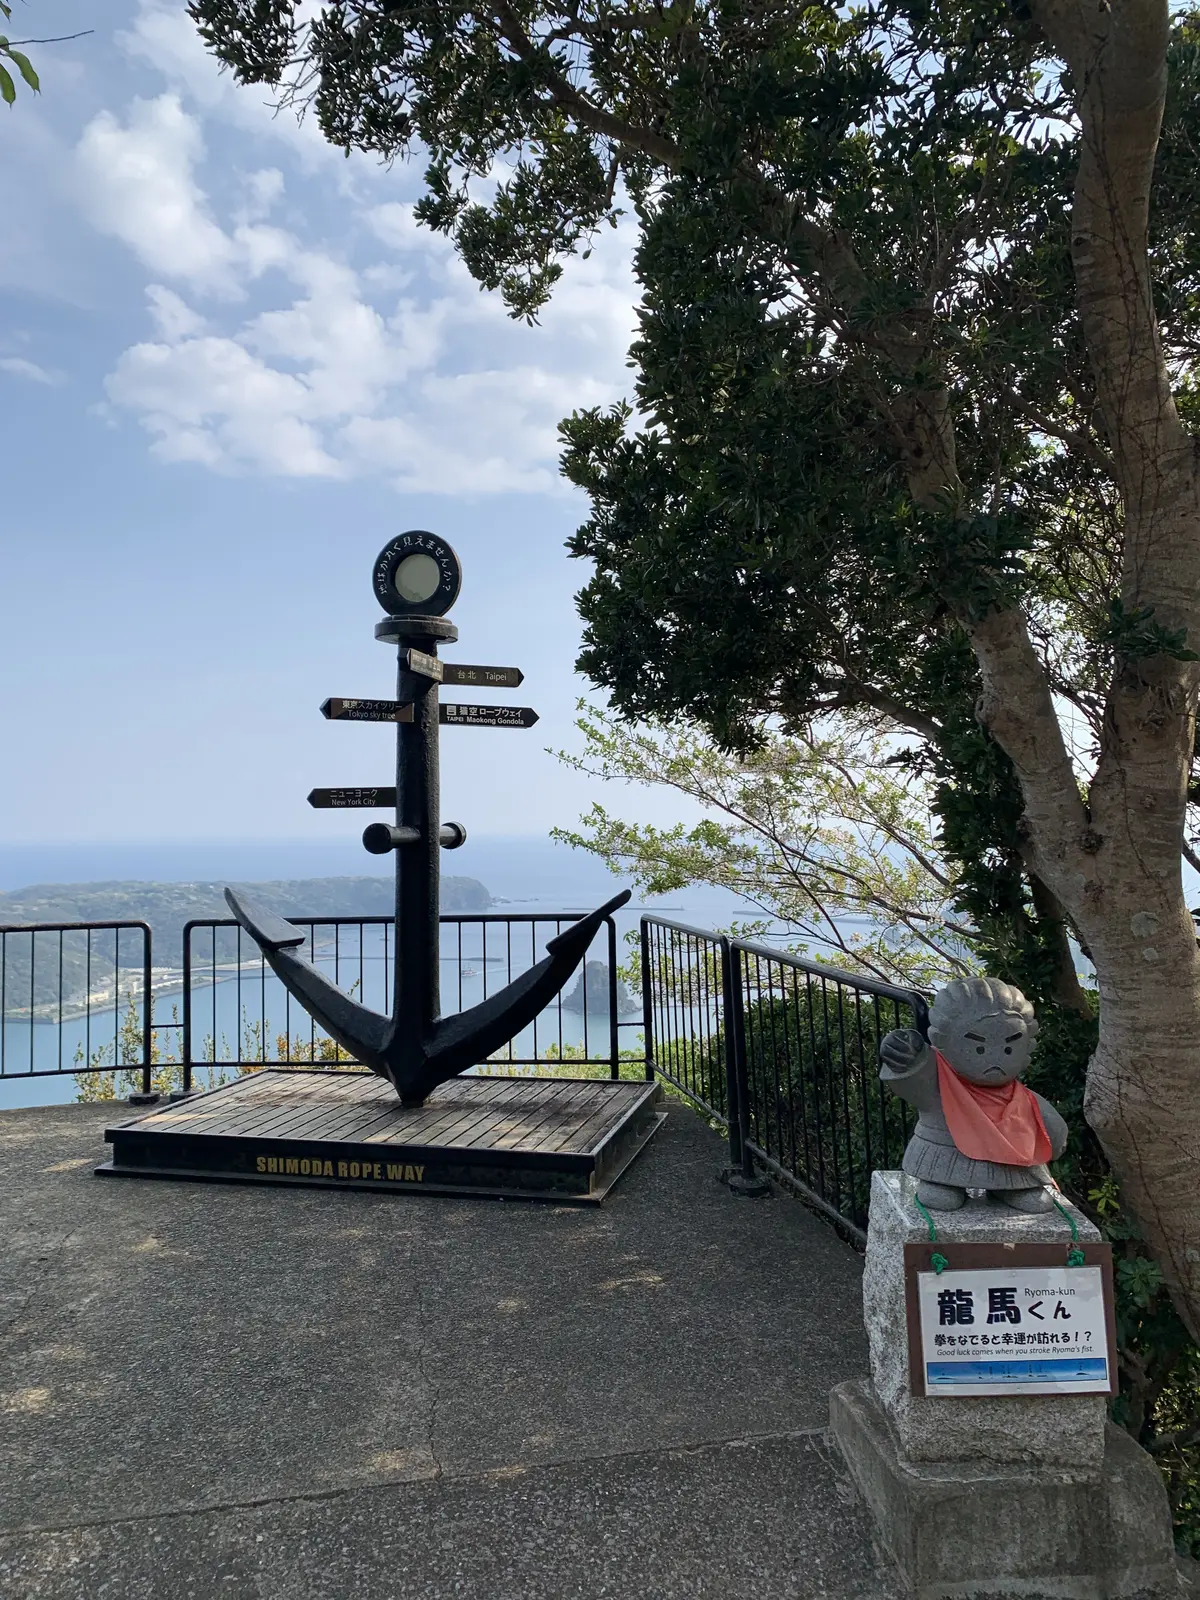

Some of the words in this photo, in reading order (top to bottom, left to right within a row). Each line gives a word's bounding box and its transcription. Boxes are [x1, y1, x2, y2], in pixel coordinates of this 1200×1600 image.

[457, 670, 477, 679] 台北
[485, 671, 507, 681] Taipei
[342, 700, 403, 710] 東京スカイツリー
[348, 710, 369, 719] Tokyo
[370, 711, 381, 719] sky
[466, 716, 497, 725] Maokong
[330, 789, 378, 798] ニューヨーク
[362, 798, 376, 806] City
[256, 1156, 334, 1177] SHIMODA
[337, 1161, 382, 1180] ROPE
[386, 1164, 425, 1182] WAY
[1024, 1287, 1076, 1298] Ryoma-kun
[937, 1287, 1072, 1326] 龍馬くん
[956, 1348, 971, 1356] luck
[972, 1348, 994, 1356] comes
[995, 1347, 1014, 1355] when
[1029, 1346, 1051, 1354] stroke
[1052, 1345, 1081, 1354] Ryoma's
[1081, 1345, 1095, 1353] fist.
